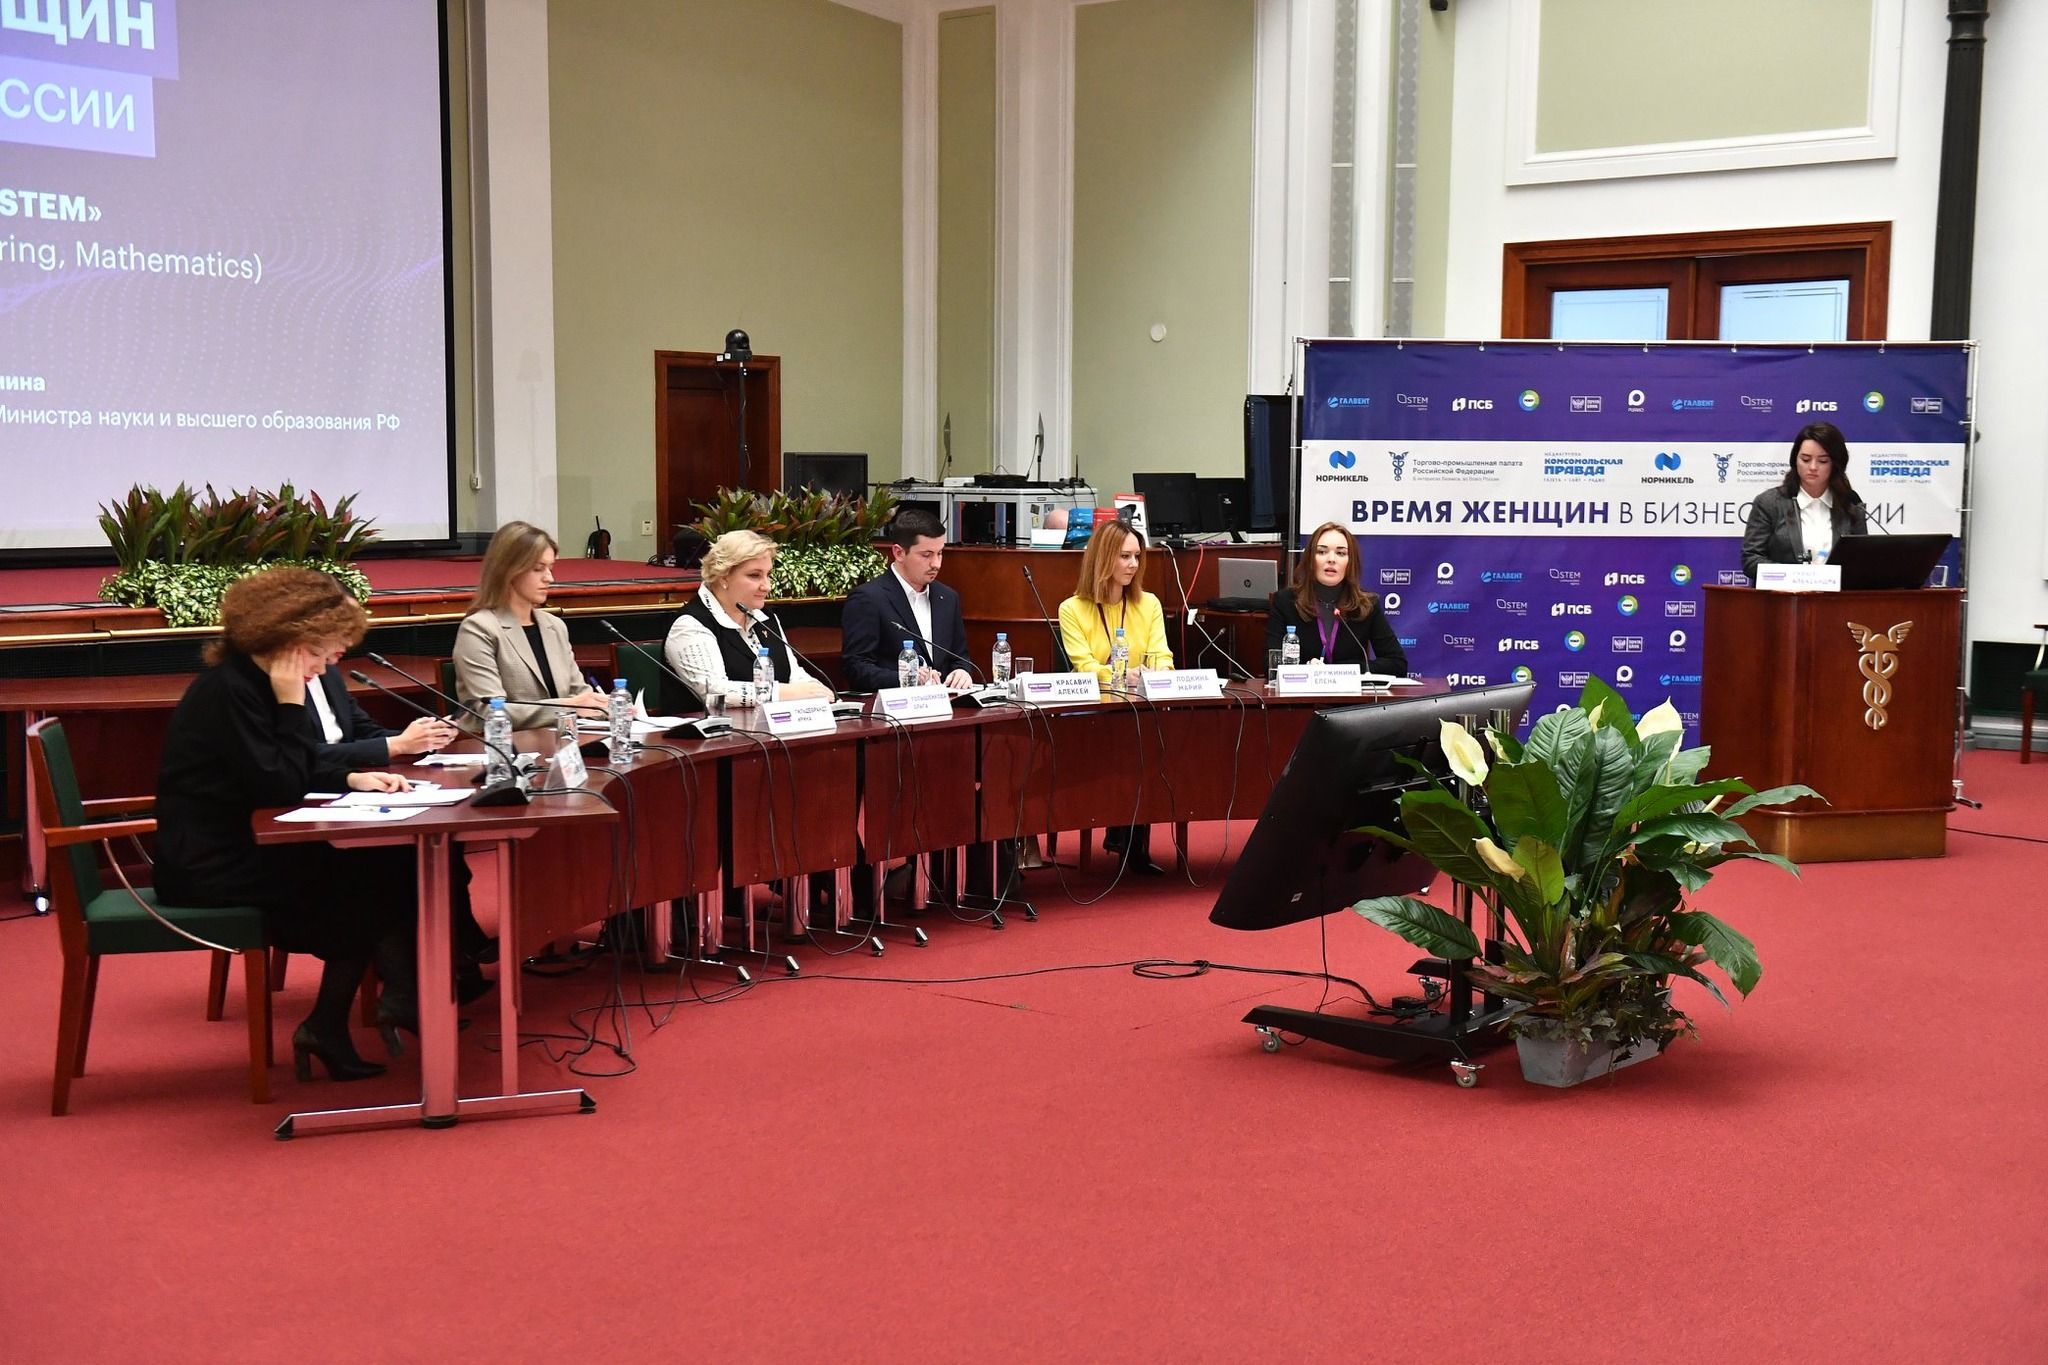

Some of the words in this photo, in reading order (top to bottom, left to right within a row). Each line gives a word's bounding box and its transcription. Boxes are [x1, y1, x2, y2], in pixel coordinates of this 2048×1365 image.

[0, 78, 135, 132] ССИИ
[76, 240, 262, 284] Mathematics)
[1407, 396, 1429, 404] STEM
[1468, 399, 1493, 410] ПСБ
[1751, 398, 1772, 406] STEM
[1812, 401, 1838, 412] ПСБ
[98, 411, 154, 430] науки
[160, 412, 171, 427] и
[176, 412, 257, 428] высшего
[262, 409, 372, 432] образования
[376, 413, 400, 431] РФ
[1413, 459, 1497, 467] Торгово-промышленная
[1413, 467, 1454, 475] Российской
[1455, 467, 1494, 476] Федерации
[1544, 465, 1605, 476] ПРАВДА
[1870, 467, 1931, 477] ПРАВДА
[1315, 474, 1369, 483] НОРНИКЕЛЬ
[1641, 476, 1694, 484] НОРНИКЕЛЬ
[1352, 500, 1452, 522] ВРЕМЯ
[1460, 500, 1609, 528] ЖЕНЩИН
[1619, 502, 1633, 524] В
[1559, 571, 1581, 579] STEM
[1620, 574, 1645, 585] ПСБ
[1567, 604, 1592, 615] ПСБ
[1454, 637, 1475, 645] STEM
[1514, 640, 1539, 650] ПСБ
[1055, 678, 1092, 686] КРАСАВИН
[1461, 675, 1486, 686] ПСБ
[1058, 686, 1089, 695] АЛЕКСЕЙ
